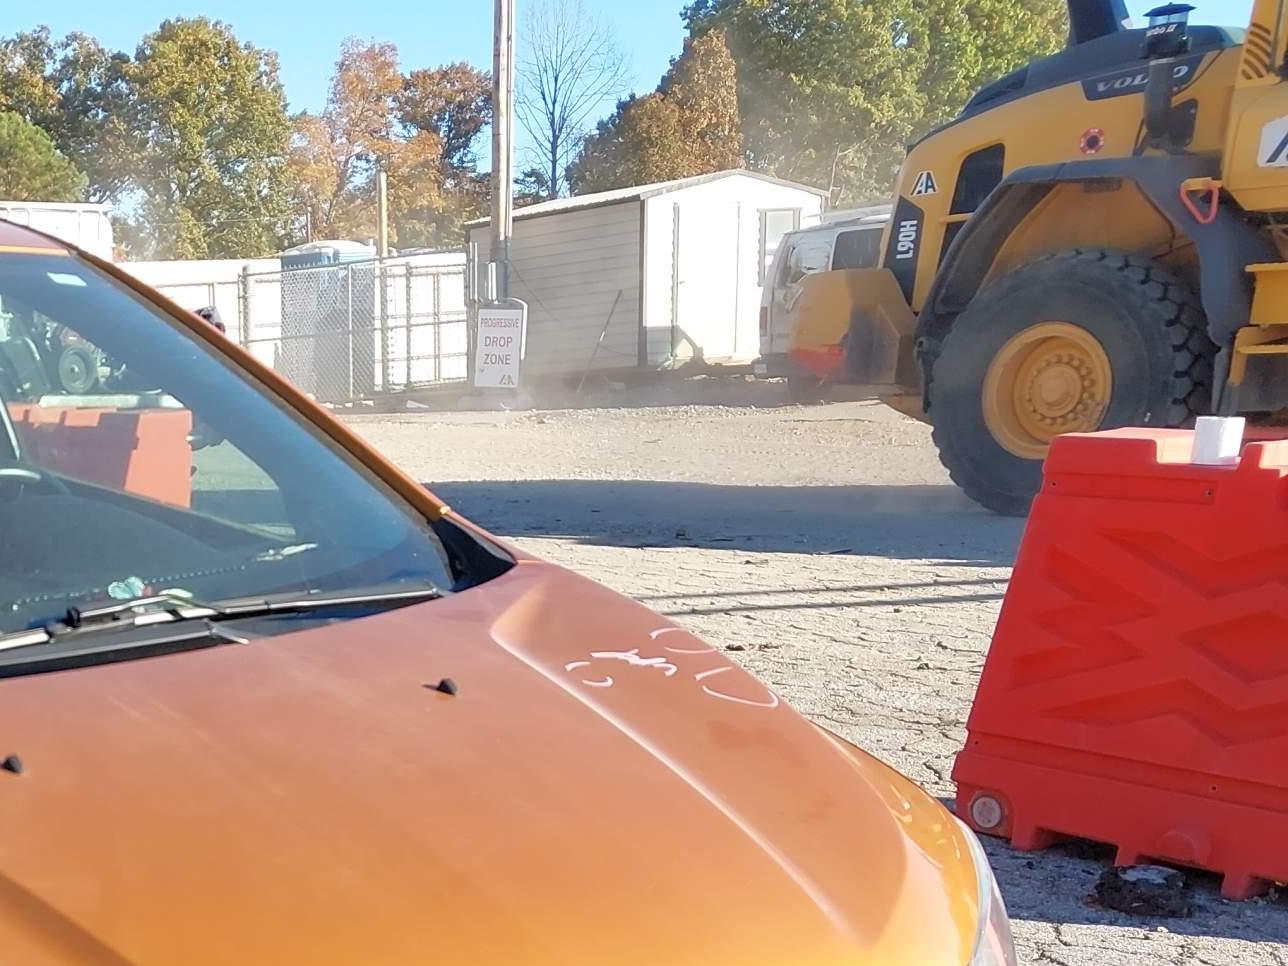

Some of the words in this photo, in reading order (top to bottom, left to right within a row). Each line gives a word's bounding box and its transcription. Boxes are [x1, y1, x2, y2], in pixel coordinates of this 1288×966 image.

[1096, 65, 1189, 92] VOLO
[895, 220, 918, 259] L90H
[480, 318, 520, 329] PROGRESSIVE
[484, 335, 513, 348] DROP
[483, 353, 512, 366] ZONE
